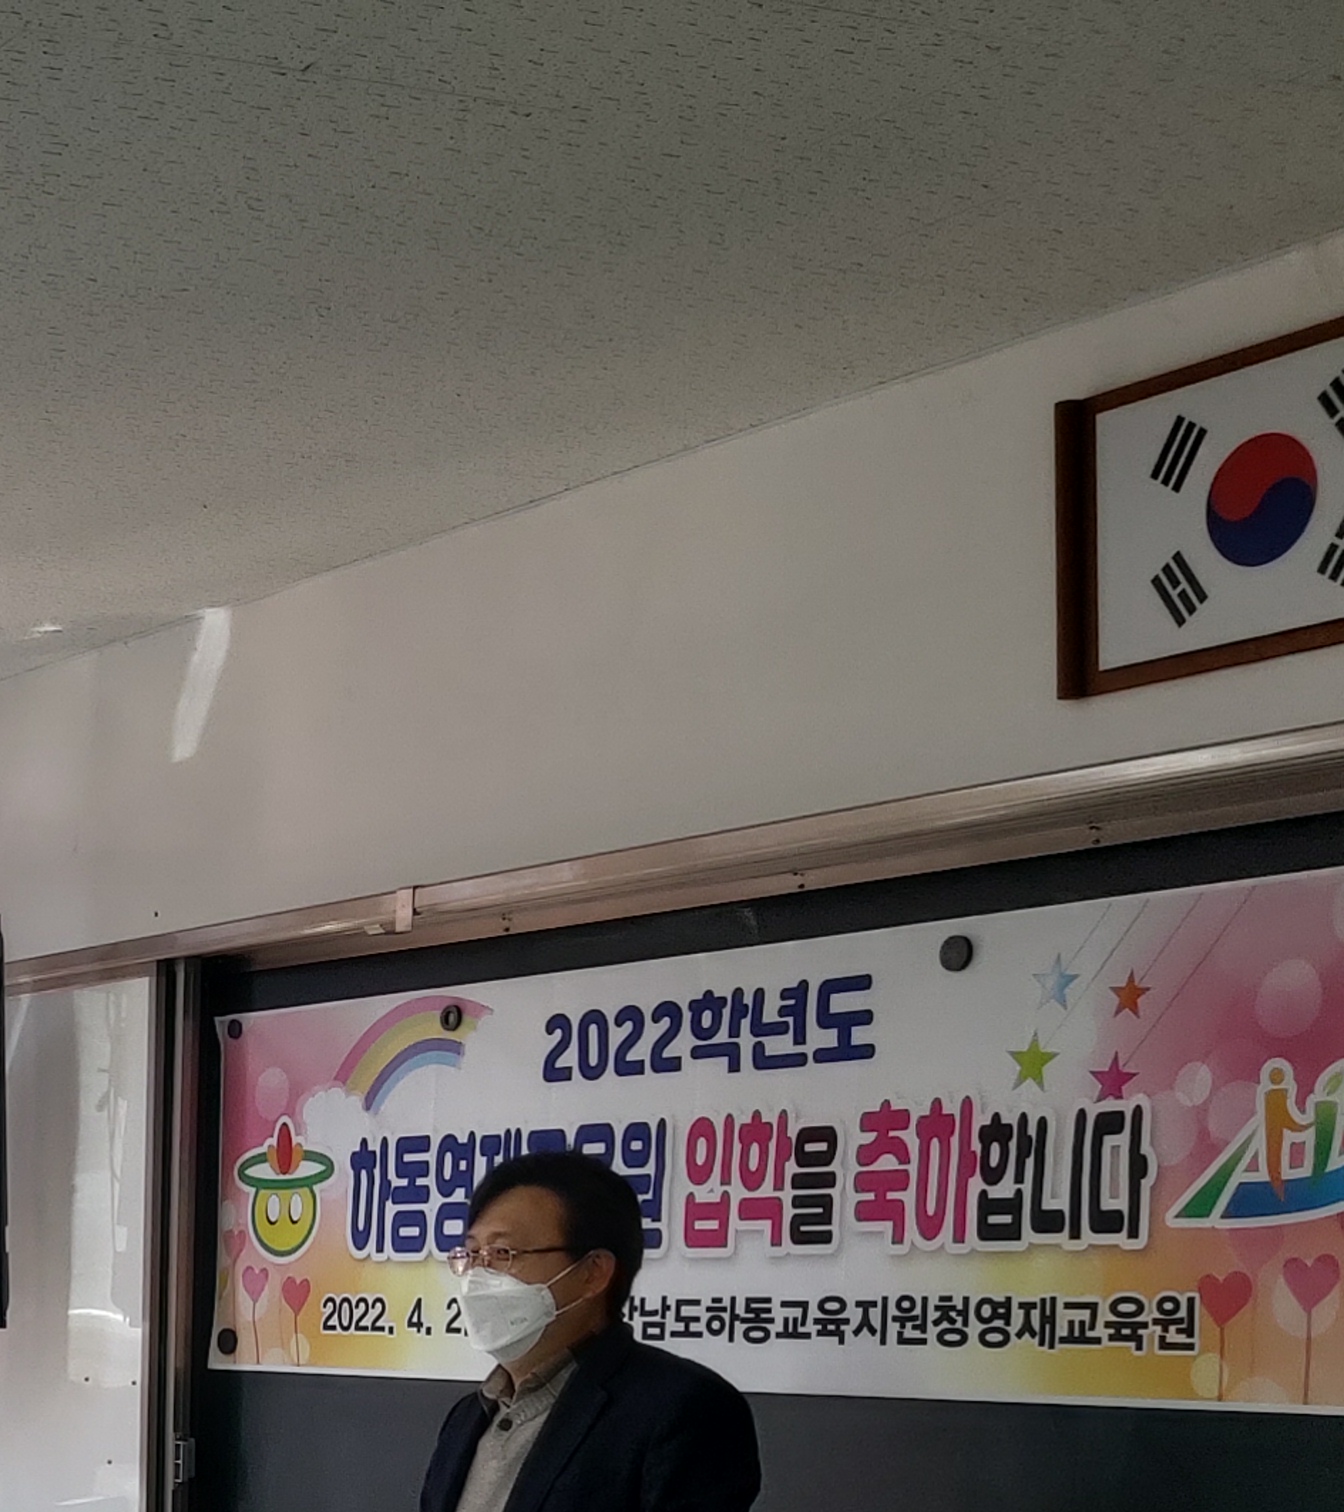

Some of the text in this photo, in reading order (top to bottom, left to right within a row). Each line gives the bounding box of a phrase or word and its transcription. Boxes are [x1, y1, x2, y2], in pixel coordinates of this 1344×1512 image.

[543, 974, 876, 1082] 2022학년도
[350, 1095, 1149, 1254] 하동영원 입학을 축하합니다
[322, 1296, 395, 1335] 2022.
[407, 1297, 432, 1336] 4.
